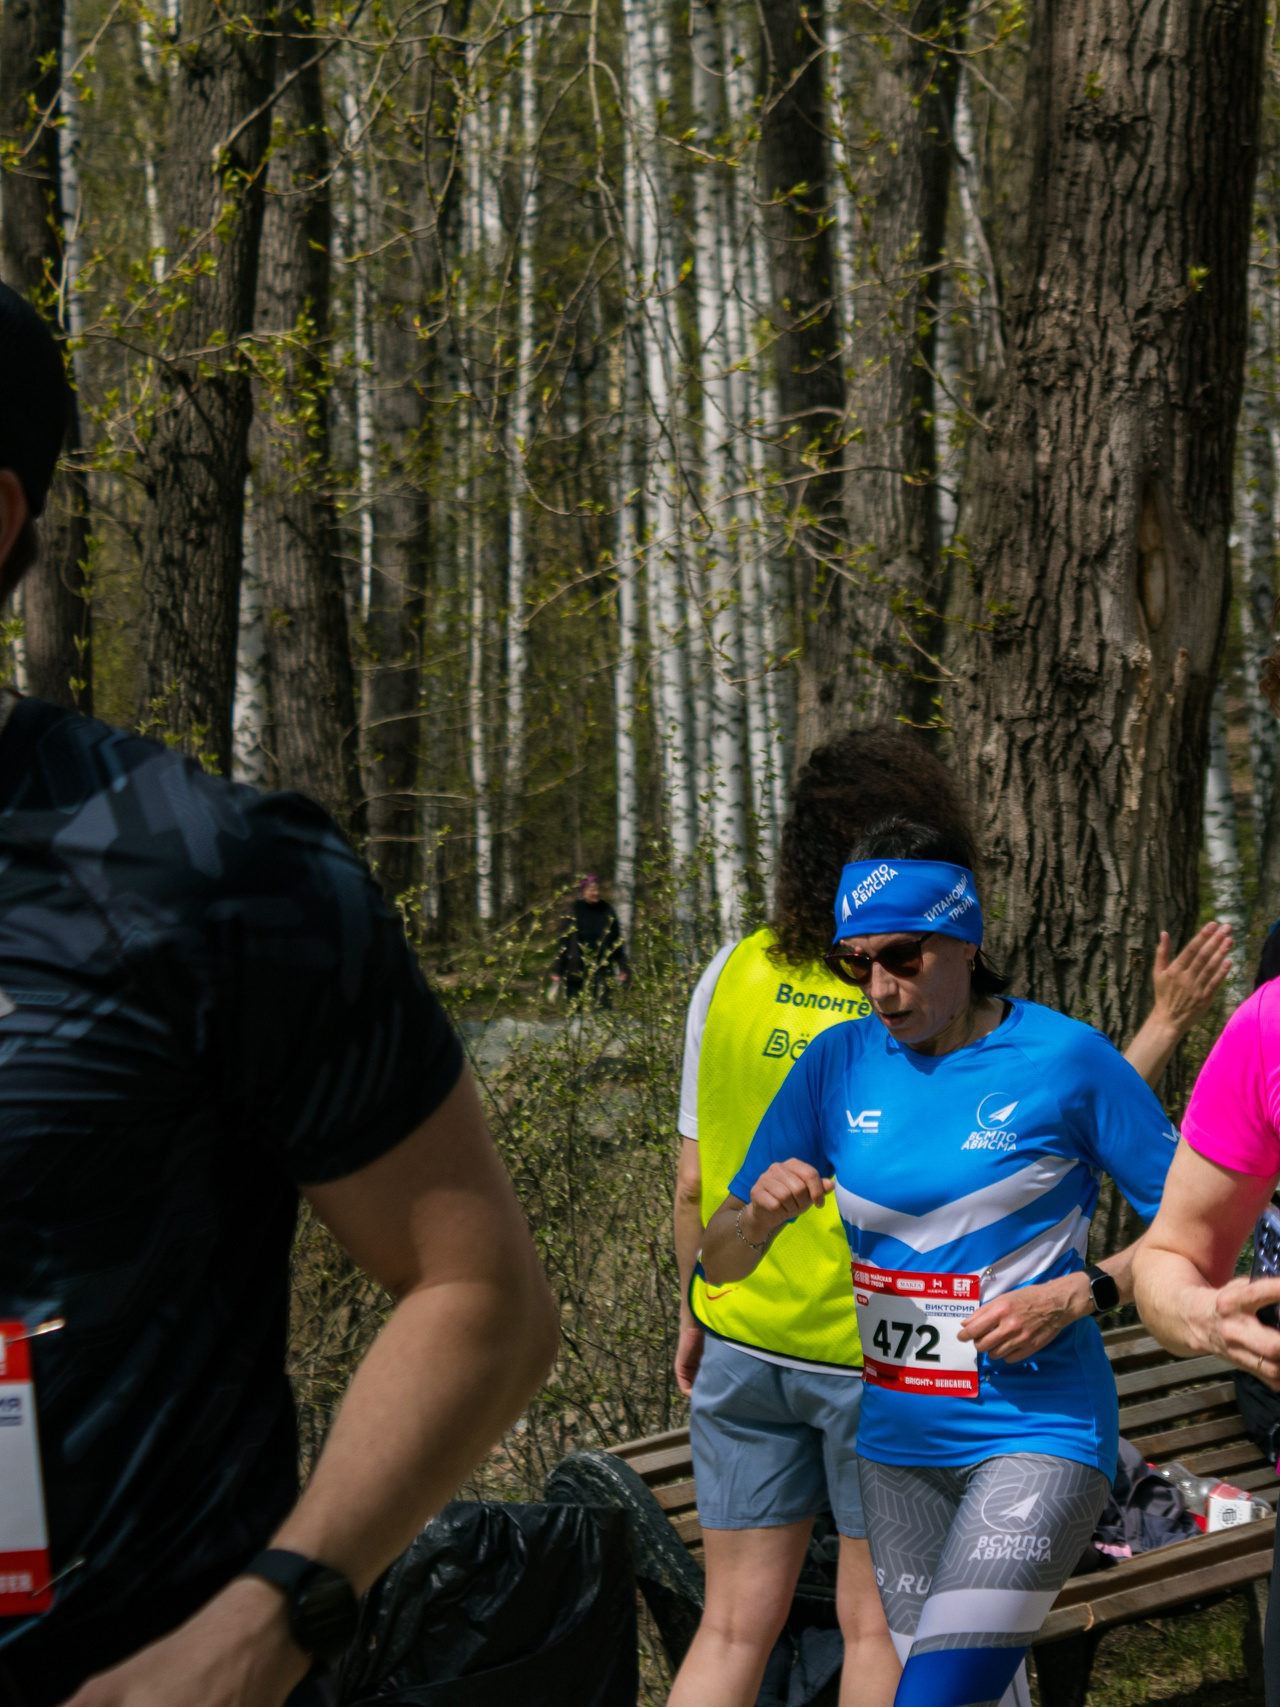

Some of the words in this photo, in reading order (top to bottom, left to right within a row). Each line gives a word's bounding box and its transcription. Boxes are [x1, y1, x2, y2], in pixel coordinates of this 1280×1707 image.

[851, 864, 889, 900] ВСМПО
[854, 868, 899, 909] АВИСМА
[923, 873, 969, 922] ТИТАНОВЫЙ
[948, 895, 975, 921] ТРЕЙЛ
[775, 983, 871, 1017] Волонтё
[960, 1140, 1017, 1151] АВИСМА
[968, 1130, 1018, 1143] ВСМПО
[925, 1303, 975, 1312] ВИКТОРИЯ
[873, 1319, 941, 1362] 472
[905, 1376, 929, 1386] BRIGHT
[968, 1547, 1051, 1562] АВИСМА
[977, 1534, 1051, 1549] ВСМПО
[874, 1566, 933, 1594] S_RU
